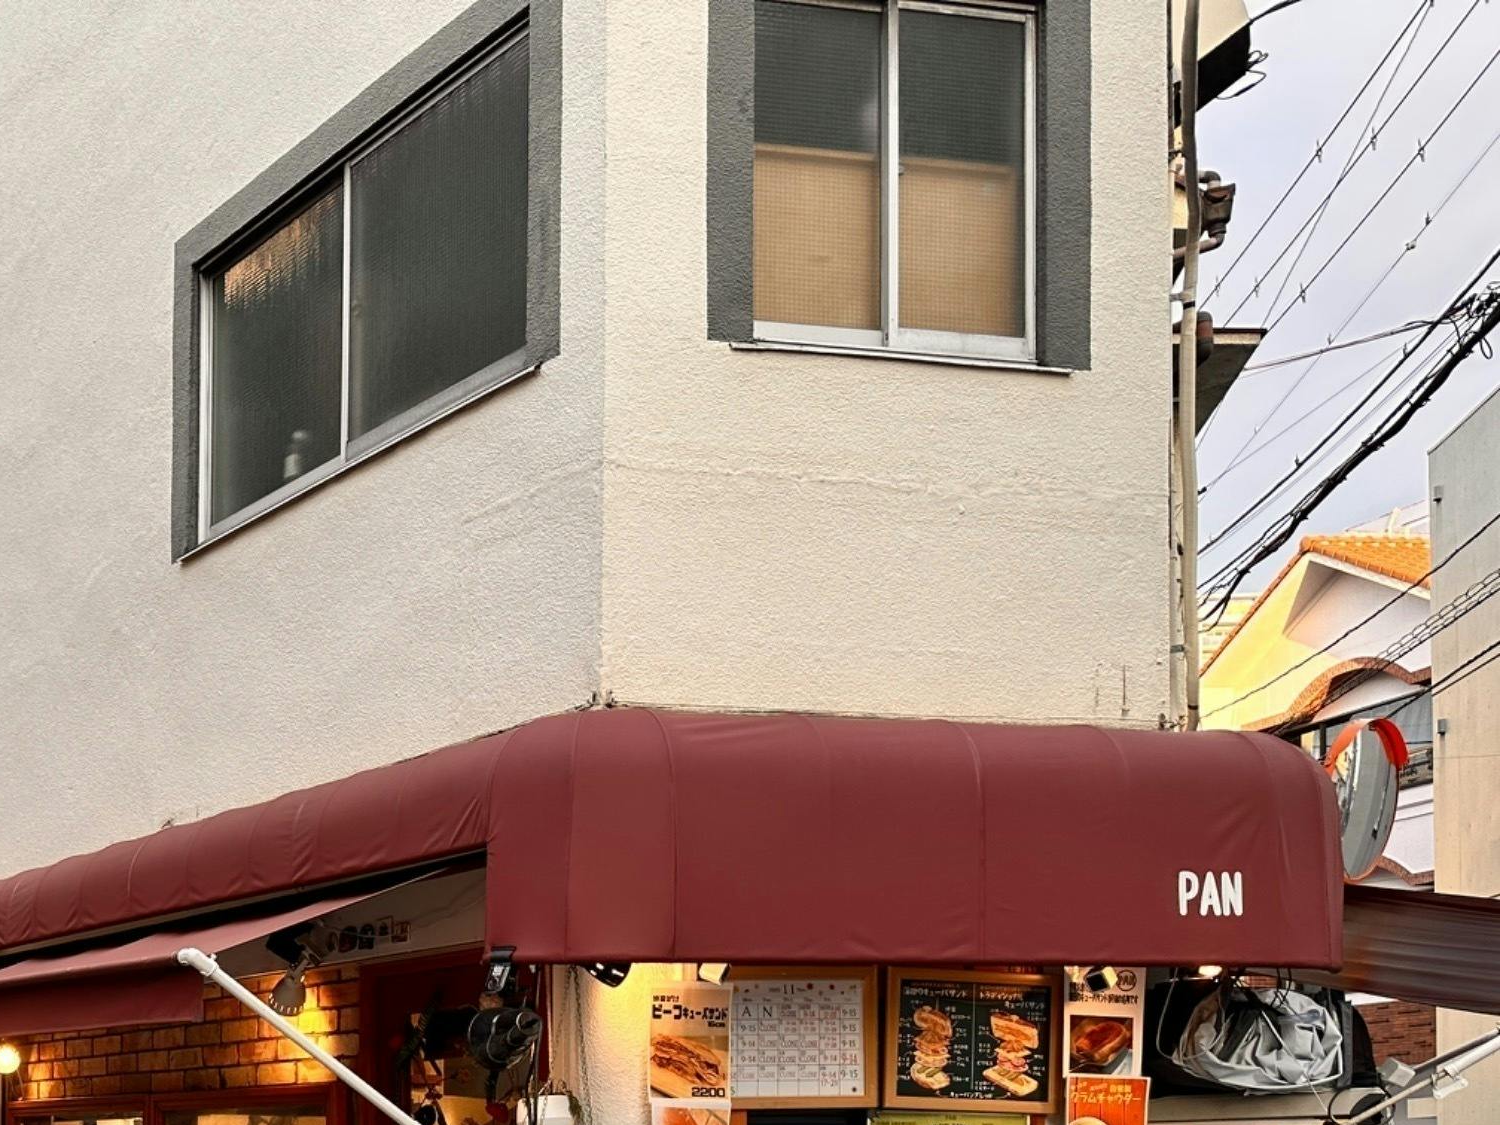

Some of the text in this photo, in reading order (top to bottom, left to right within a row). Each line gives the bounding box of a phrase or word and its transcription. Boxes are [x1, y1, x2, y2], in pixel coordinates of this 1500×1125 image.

[1179, 870, 1243, 916] PAN
[652, 1004, 729, 1020] ビーフキューバサンド
[691, 1087, 726, 1098] 2200
